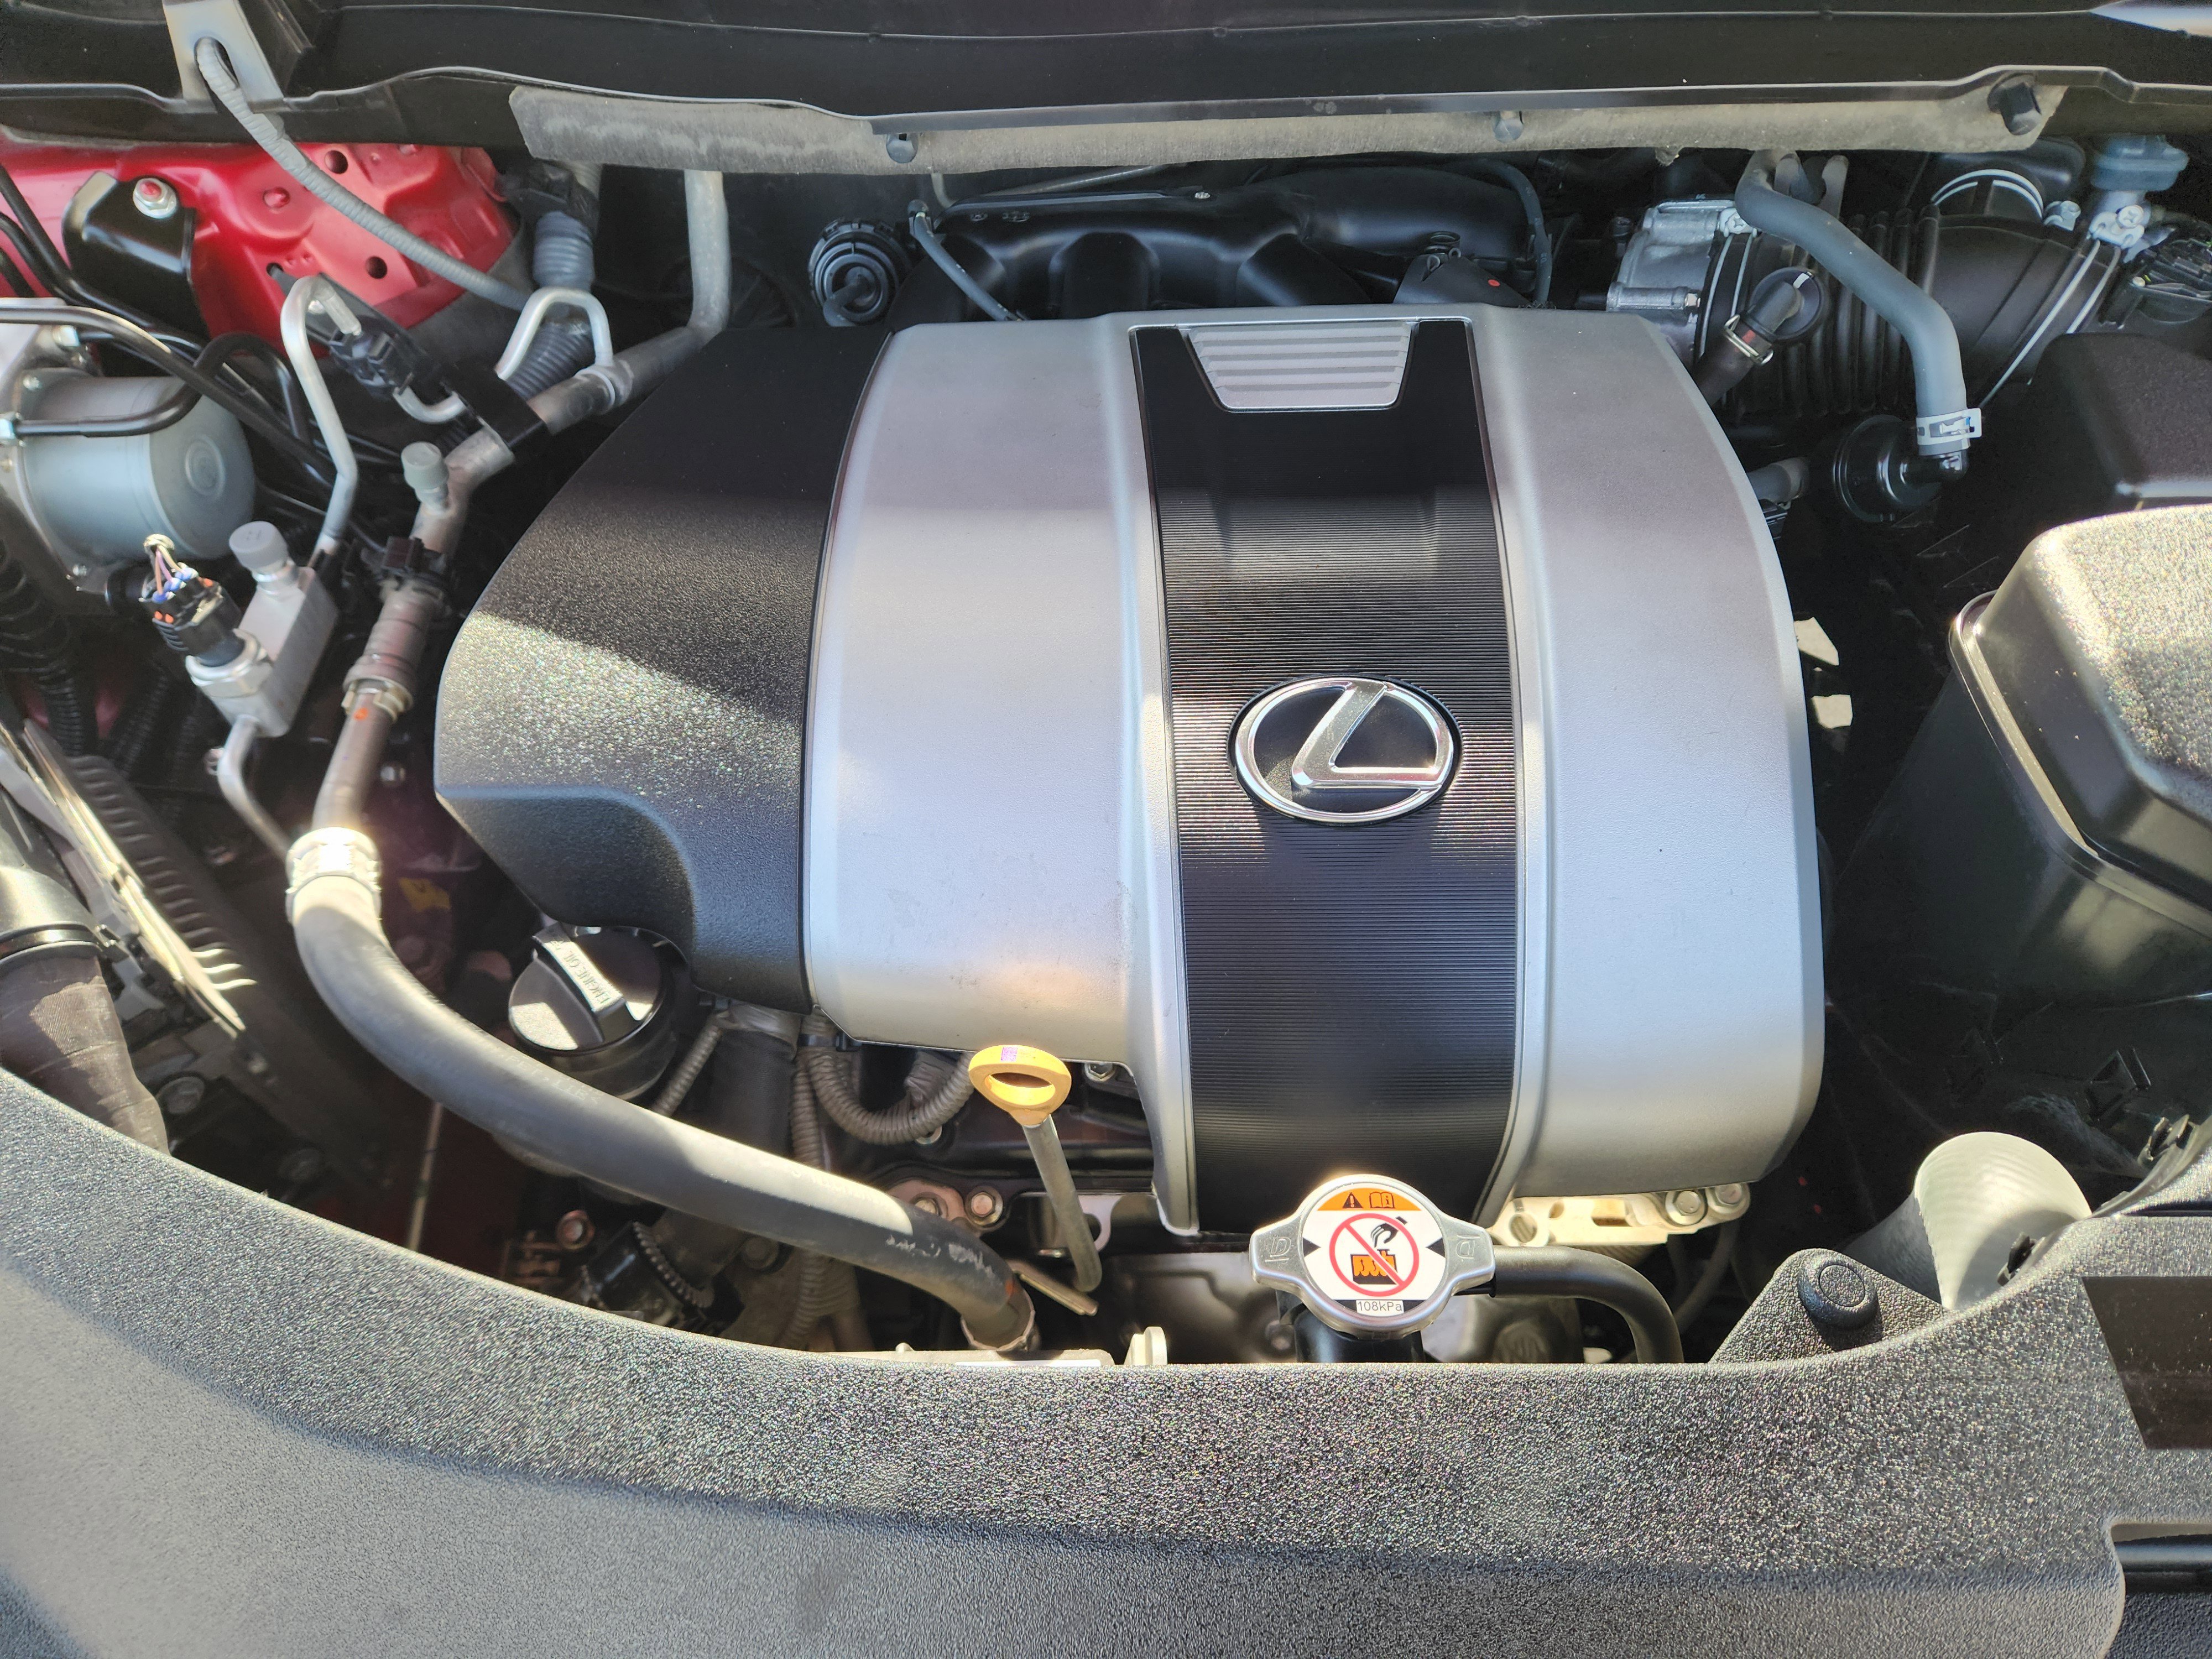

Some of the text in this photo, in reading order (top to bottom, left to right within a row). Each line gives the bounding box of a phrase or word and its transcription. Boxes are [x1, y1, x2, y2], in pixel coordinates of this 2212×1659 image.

[562, 950, 611, 1004] ENGINE OIL
[1358, 1301, 1402, 1312] 108kPa
